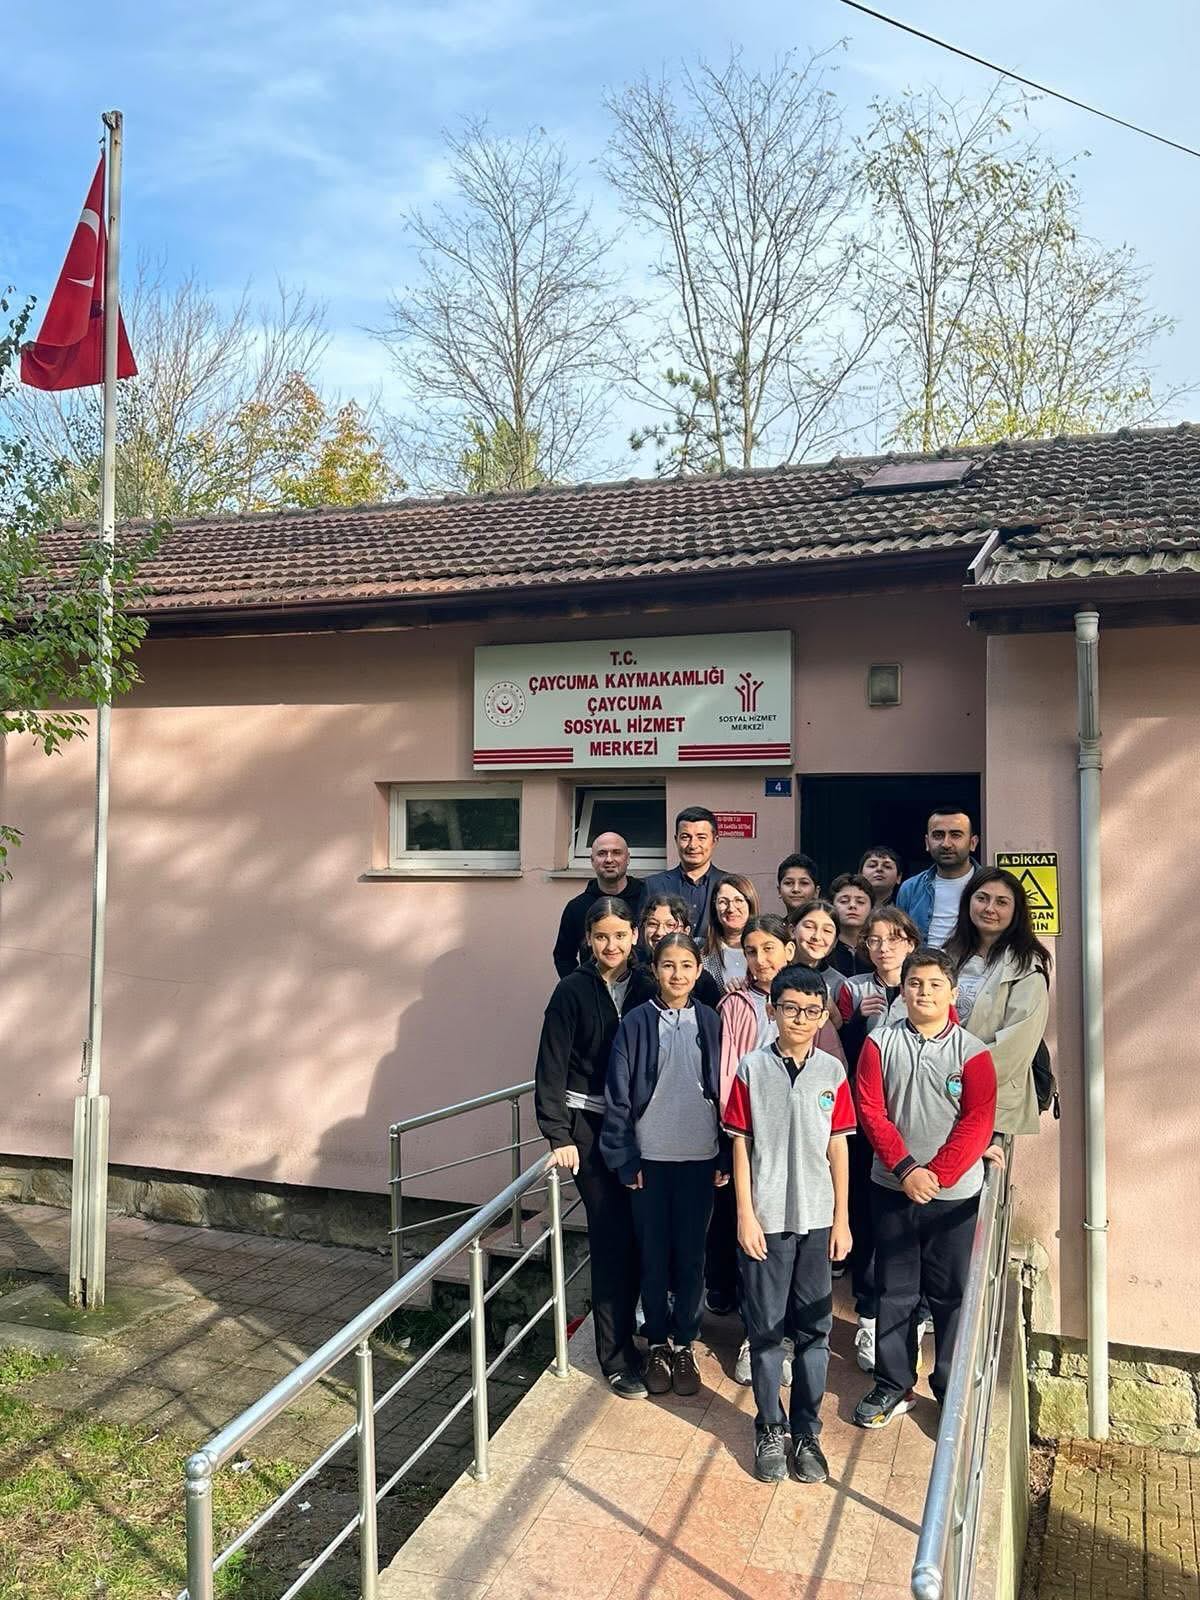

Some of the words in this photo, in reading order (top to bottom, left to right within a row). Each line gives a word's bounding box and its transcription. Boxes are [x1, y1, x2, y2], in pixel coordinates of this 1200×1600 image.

[610, 650, 637, 666] T.C.
[529, 673, 599, 695] ÇAYCUMA
[605, 666, 724, 689] KAYMAKAMLIĞI
[587, 695, 662, 716] ÇAYCUMA
[563, 718, 621, 734] SOSYAL
[627, 714, 685, 733] HİZMET
[719, 715, 747, 723] SOSYAL
[731, 722, 764, 731] MERKEZİ
[589, 737, 658, 757] MERKEZİ
[775, 782, 782, 792] 4
[1012, 854, 1055, 865] DİKKAT
[1029, 911, 1054, 920] GAN
